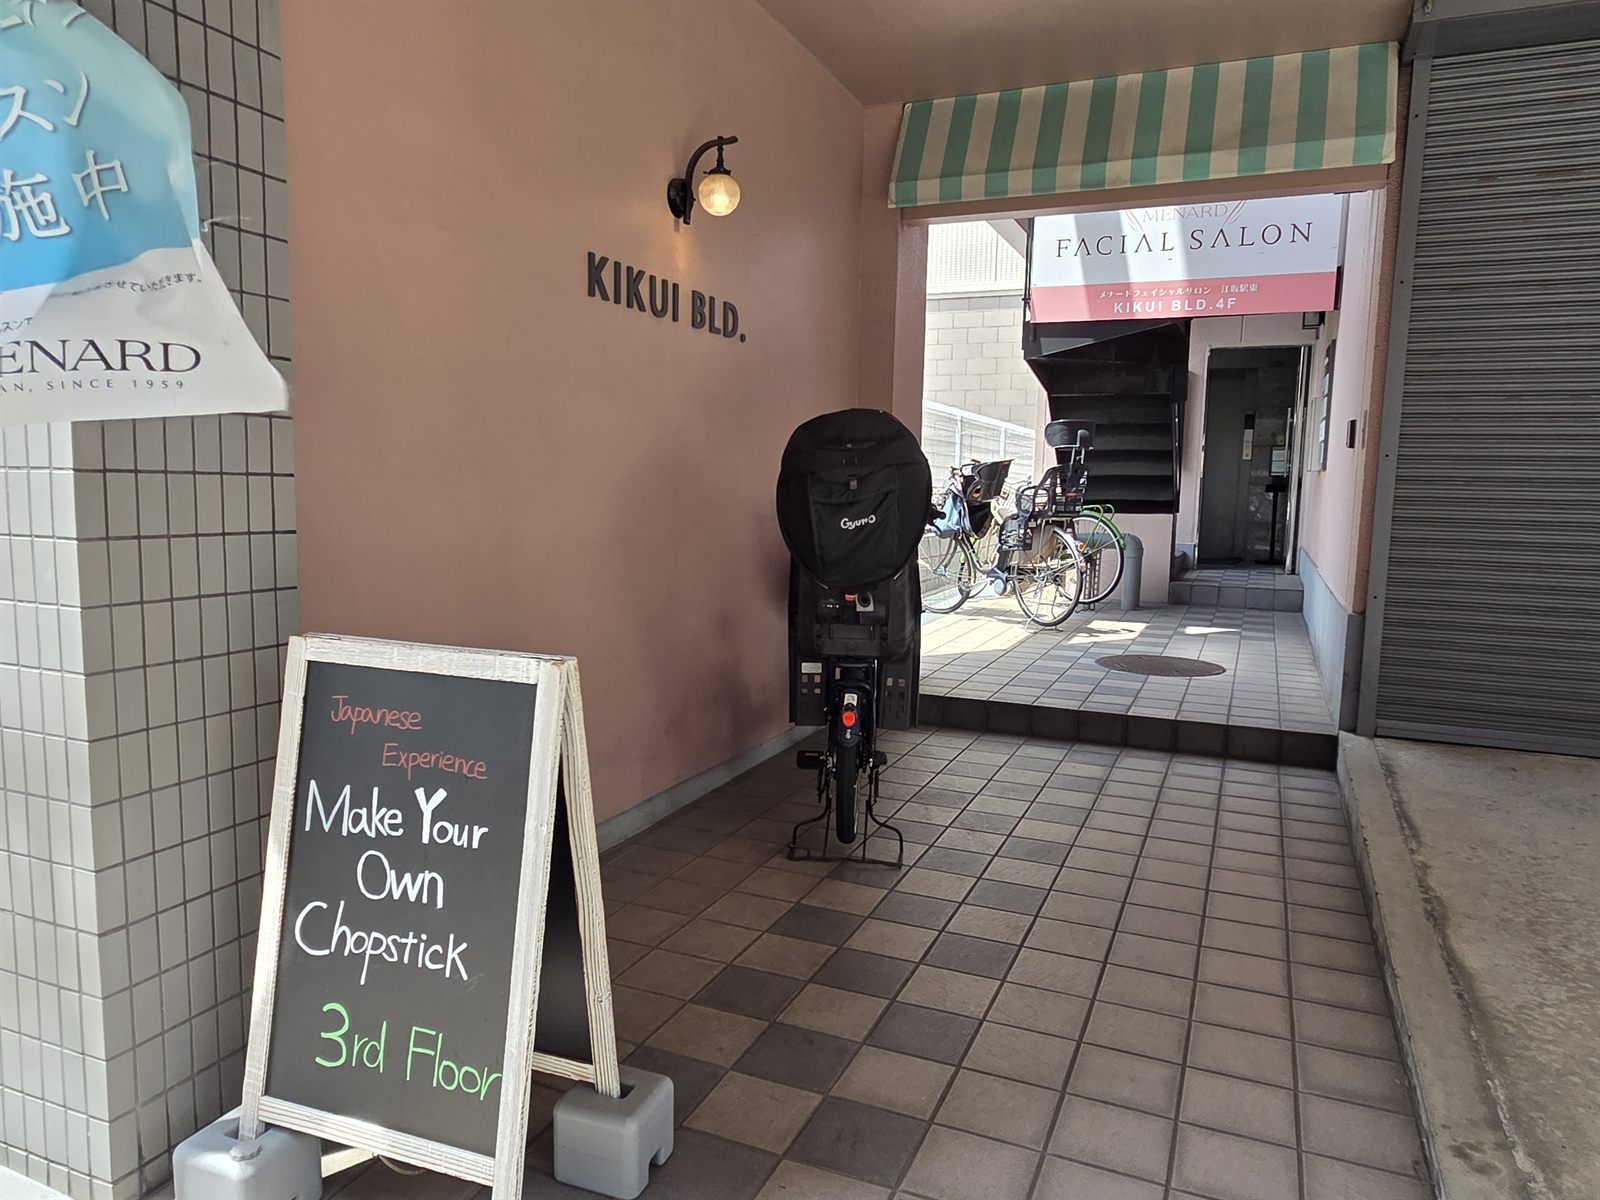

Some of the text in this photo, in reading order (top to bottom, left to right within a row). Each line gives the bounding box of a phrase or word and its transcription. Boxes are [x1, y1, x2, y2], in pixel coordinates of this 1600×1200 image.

[1143, 203, 1229, 223] MENARD
[1056, 221, 1314, 258] FACIAL SALON
[587, 251, 747, 343] KIKUI BLD.
[1113, 300, 1163, 314] KIKUI
[46, 379, 115, 391] SINCE
[133, 379, 185, 390] 1959
[331, 695, 423, 735] Japanese
[382, 742, 488, 781] Experience
[304, 779, 489, 849] Make Your
[356, 850, 444, 909] Own
[294, 900, 469, 986] Chopstick
[314, 1002, 503, 1101] 3rd Floor
